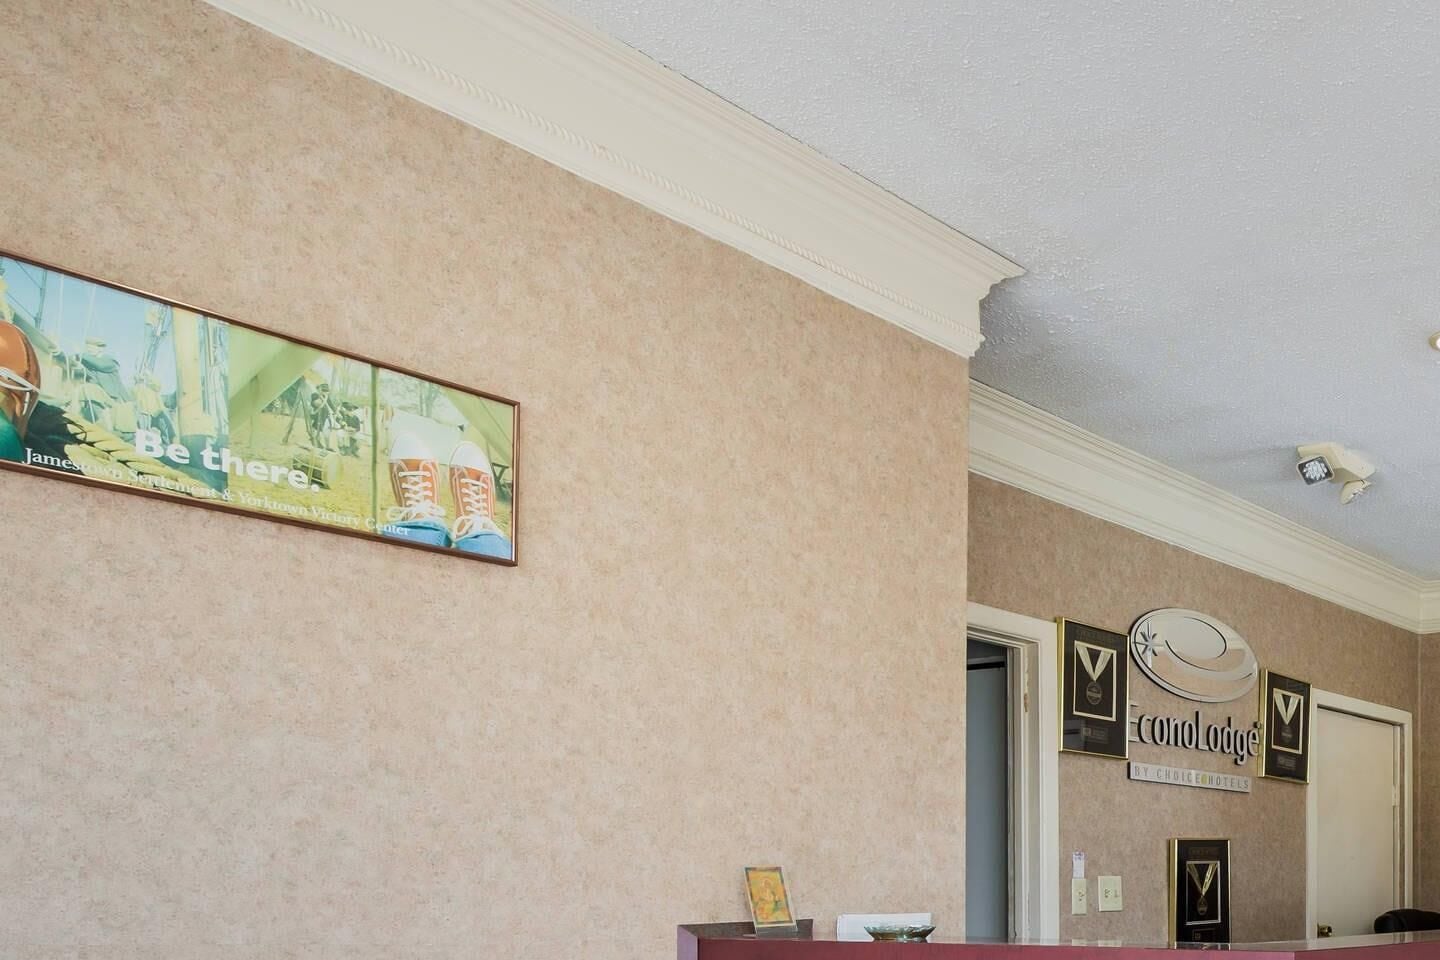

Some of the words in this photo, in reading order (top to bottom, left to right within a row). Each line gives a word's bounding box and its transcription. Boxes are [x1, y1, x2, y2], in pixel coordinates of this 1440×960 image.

[21, 447, 124, 480] Jamestown
[221, 488, 233, 502] &
[238, 493, 310, 517] Yorktown
[311, 506, 361, 527] Victory
[364, 517, 411, 537] Center
[134, 427, 189, 464] Be
[199, 446, 321, 493] there.
[1128, 704, 1260, 766] EconoLodge
[1134, 766, 1148, 777] BY
[1156, 769, 1200, 784] CHOICE
[1207, 774, 1249, 788] HOTELS
